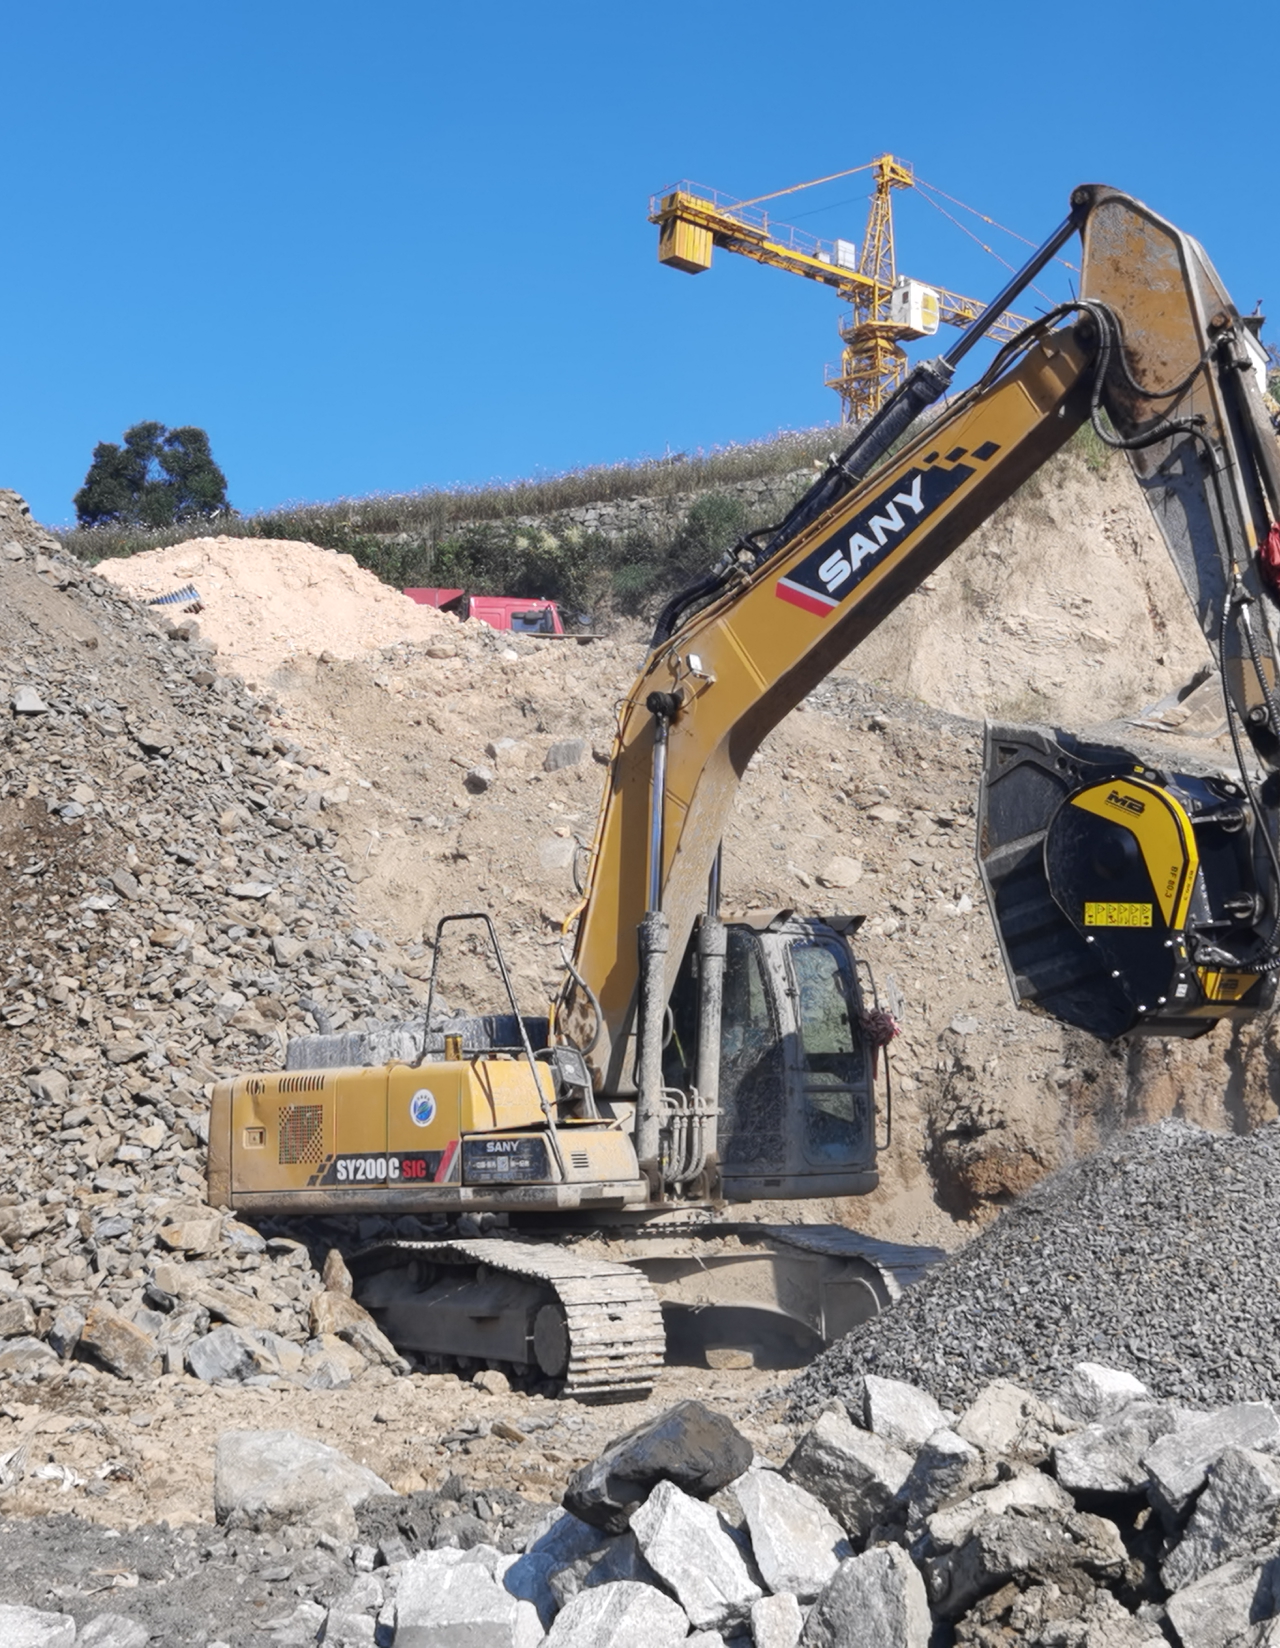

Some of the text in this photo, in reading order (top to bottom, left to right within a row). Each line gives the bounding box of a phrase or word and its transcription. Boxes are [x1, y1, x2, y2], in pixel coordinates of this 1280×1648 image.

[818, 473, 925, 593] SANY
[1106, 789, 1145, 814] MB
[486, 1141, 519, 1152] SANY
[402, 1160, 426, 1178] SIC
